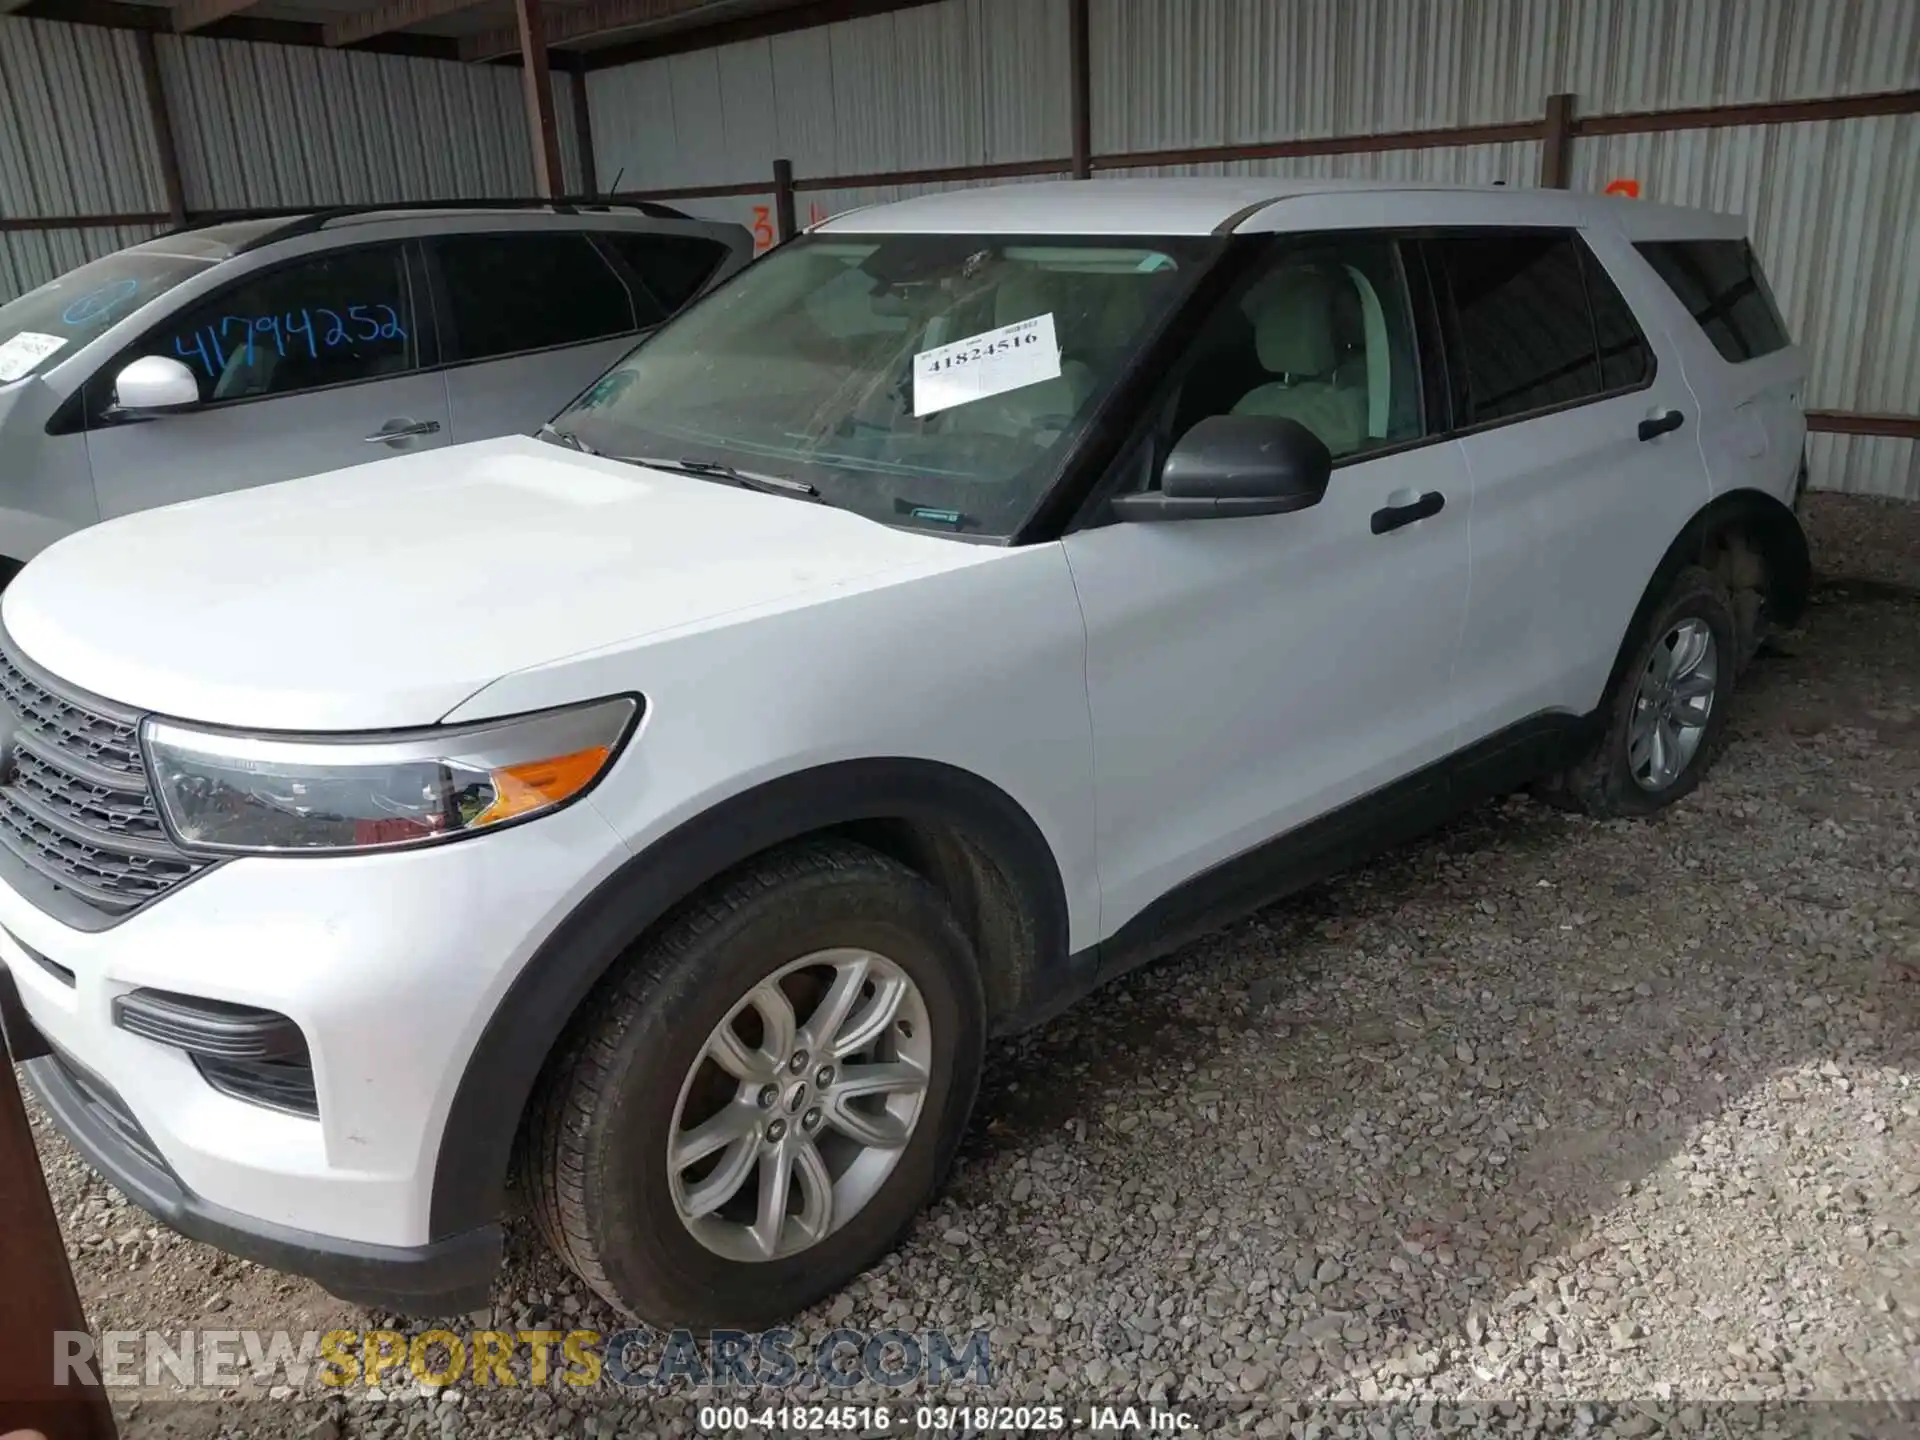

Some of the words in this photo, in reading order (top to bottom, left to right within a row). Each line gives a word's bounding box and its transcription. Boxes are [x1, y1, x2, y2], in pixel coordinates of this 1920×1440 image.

[752, 205, 774, 249] 3
[175, 303, 408, 377] 41794252
[927, 332, 1038, 373] 41824516
